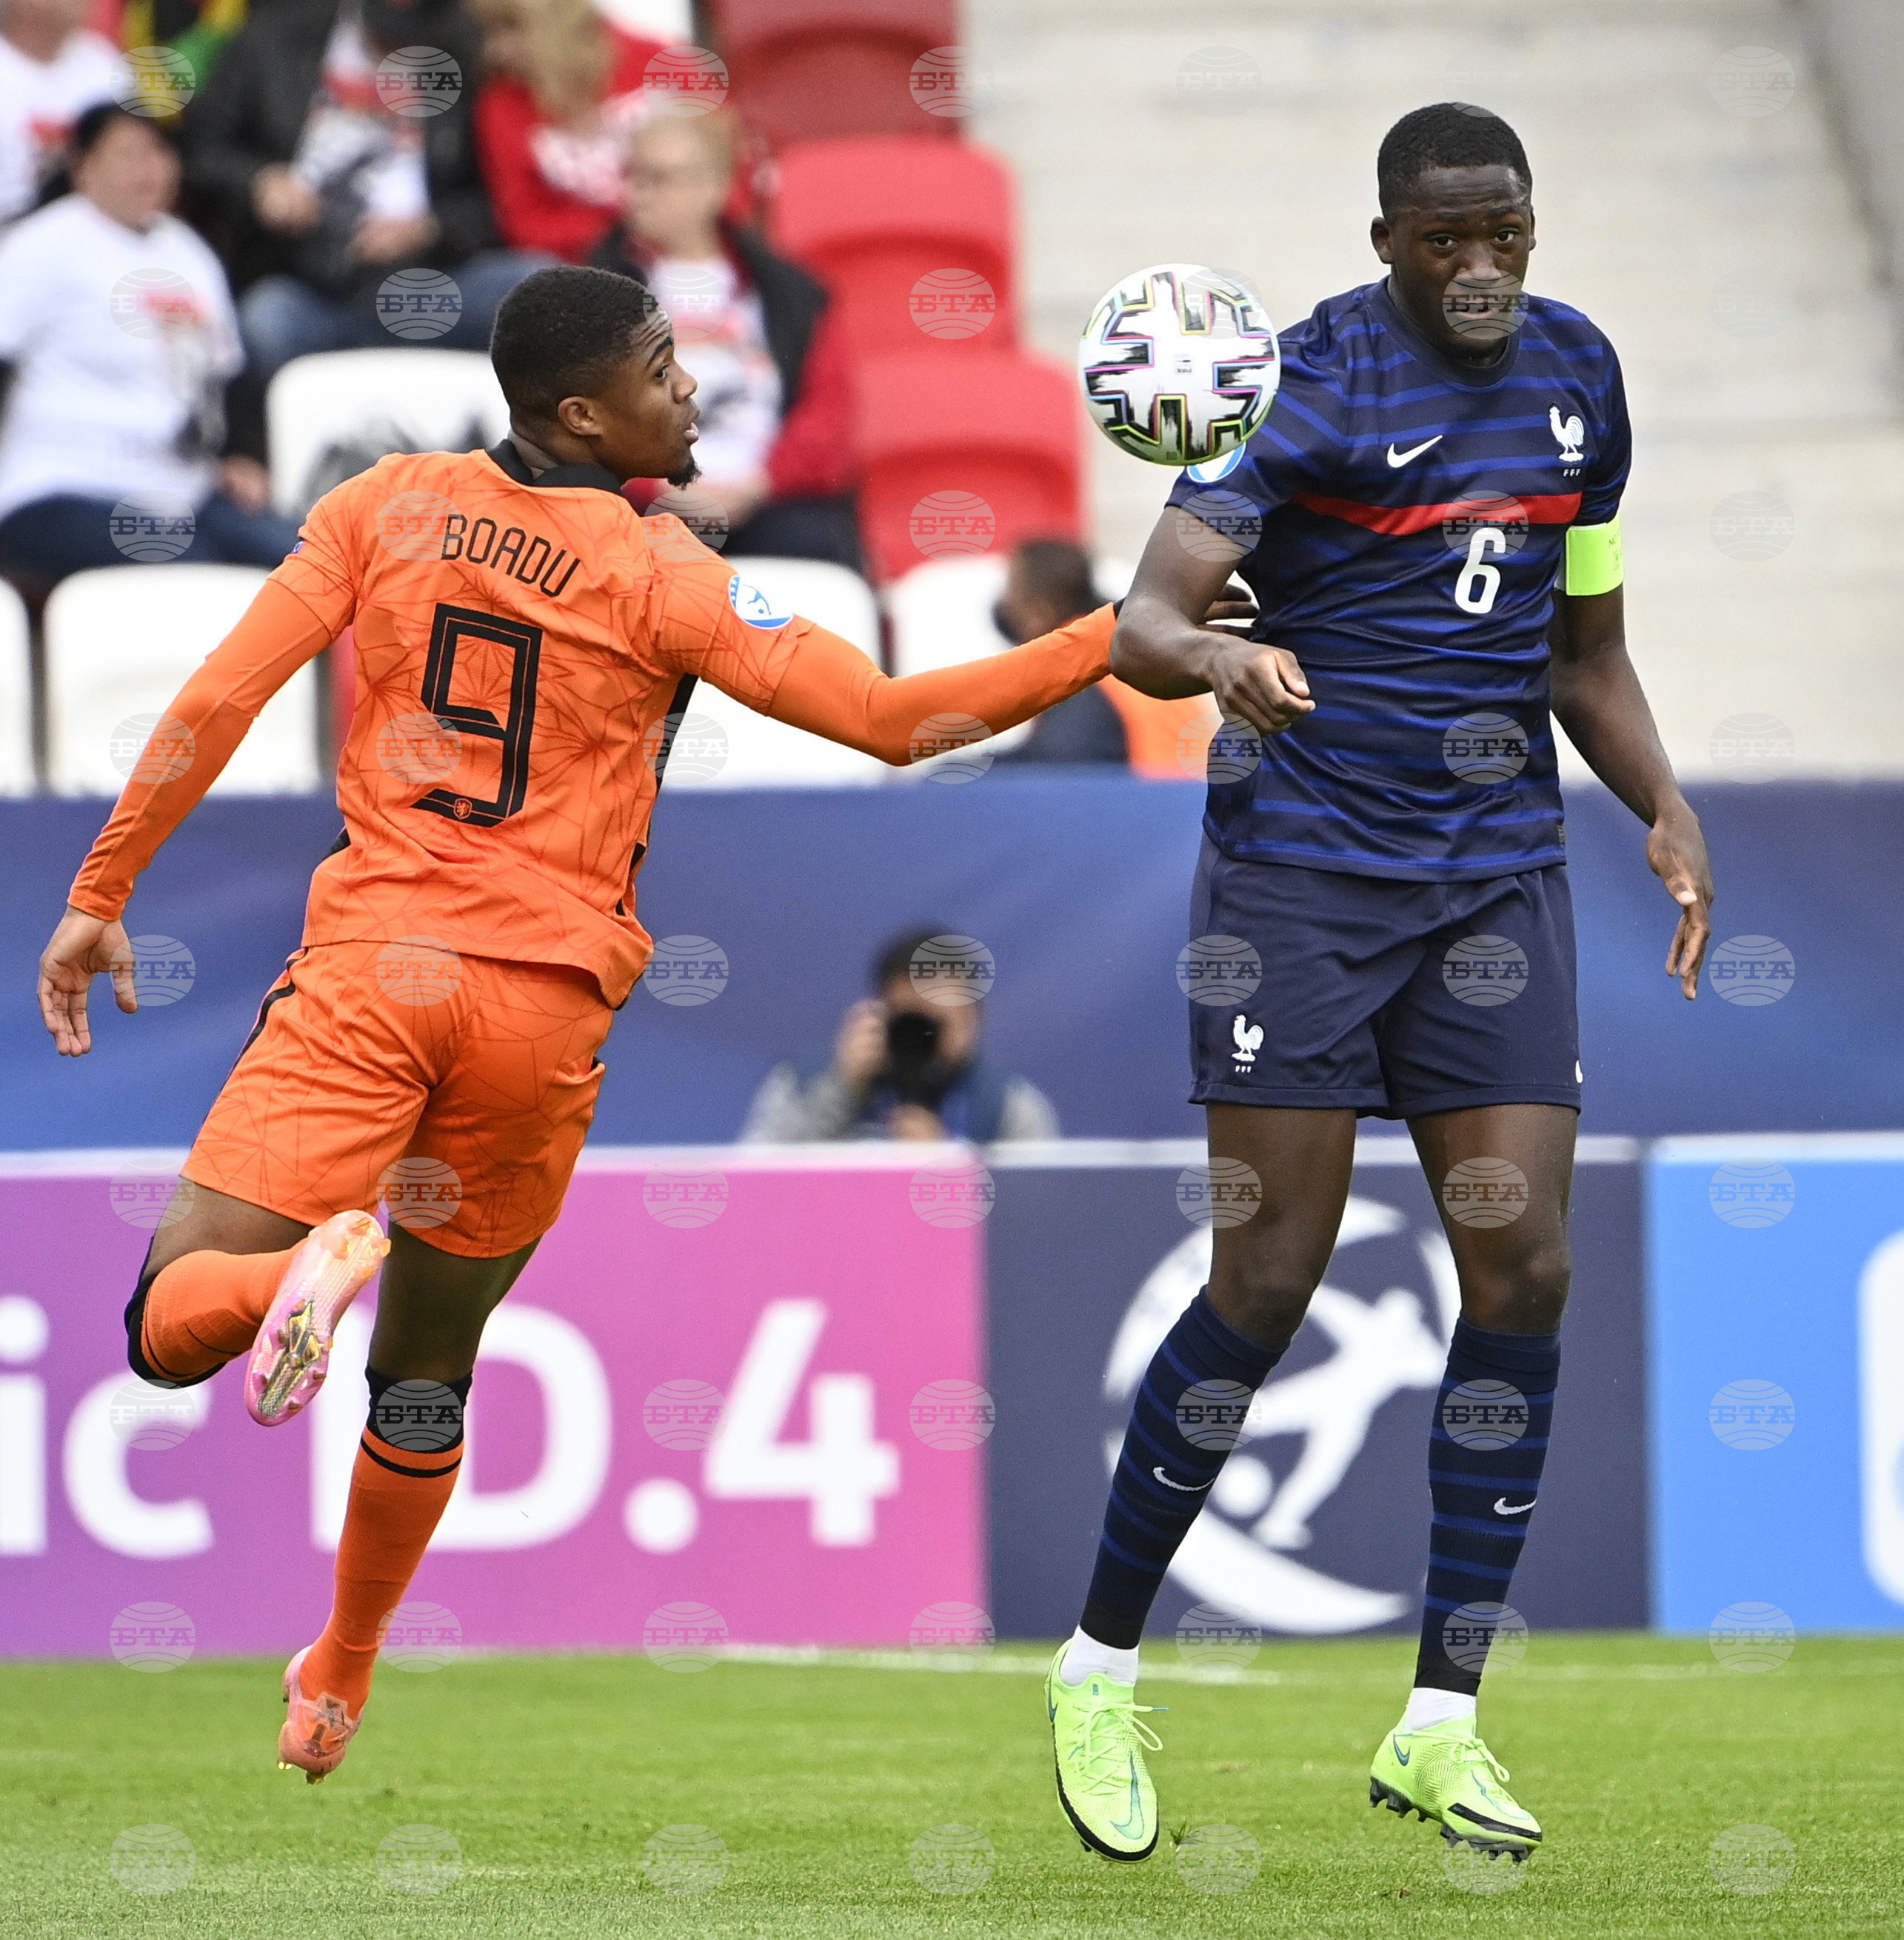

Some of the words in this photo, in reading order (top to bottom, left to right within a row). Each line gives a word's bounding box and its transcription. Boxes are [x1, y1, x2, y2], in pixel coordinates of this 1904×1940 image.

[441, 514, 581, 598] BOADU
[1454, 527, 1506, 613] 6
[410, 602, 543, 827] 9
[311, 1299, 901, 1553] ID.4
